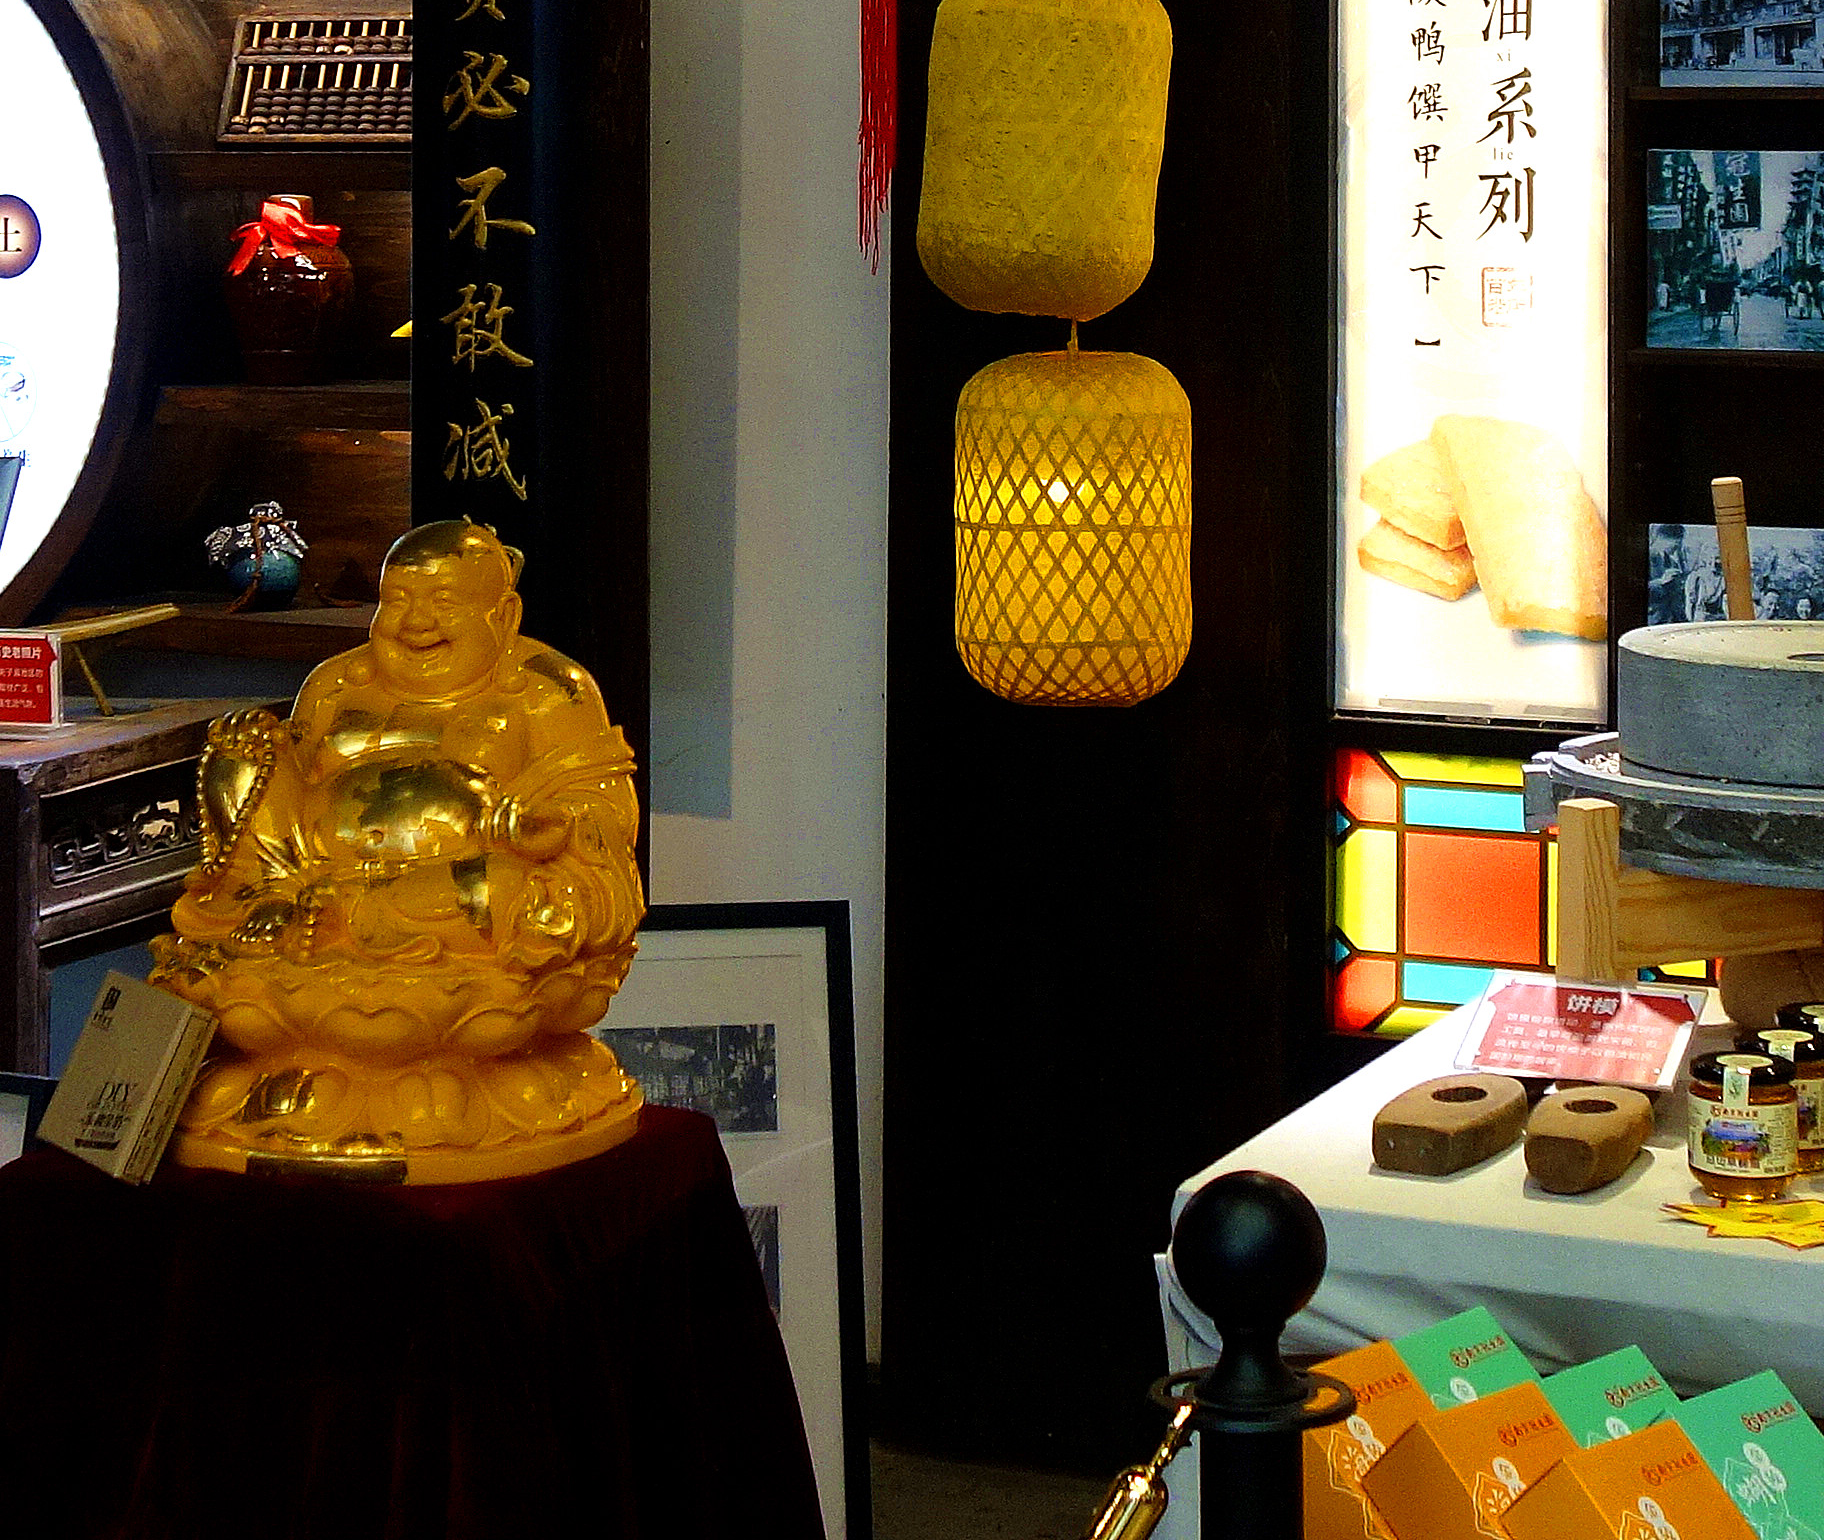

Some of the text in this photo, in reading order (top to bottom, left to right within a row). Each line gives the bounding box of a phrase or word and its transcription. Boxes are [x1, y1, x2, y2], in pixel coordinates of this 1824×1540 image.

[1496, 49, 1512, 63] xi
[1493, 147, 1515, 162] lie
[1567, 993, 1620, 1017] 饼模
